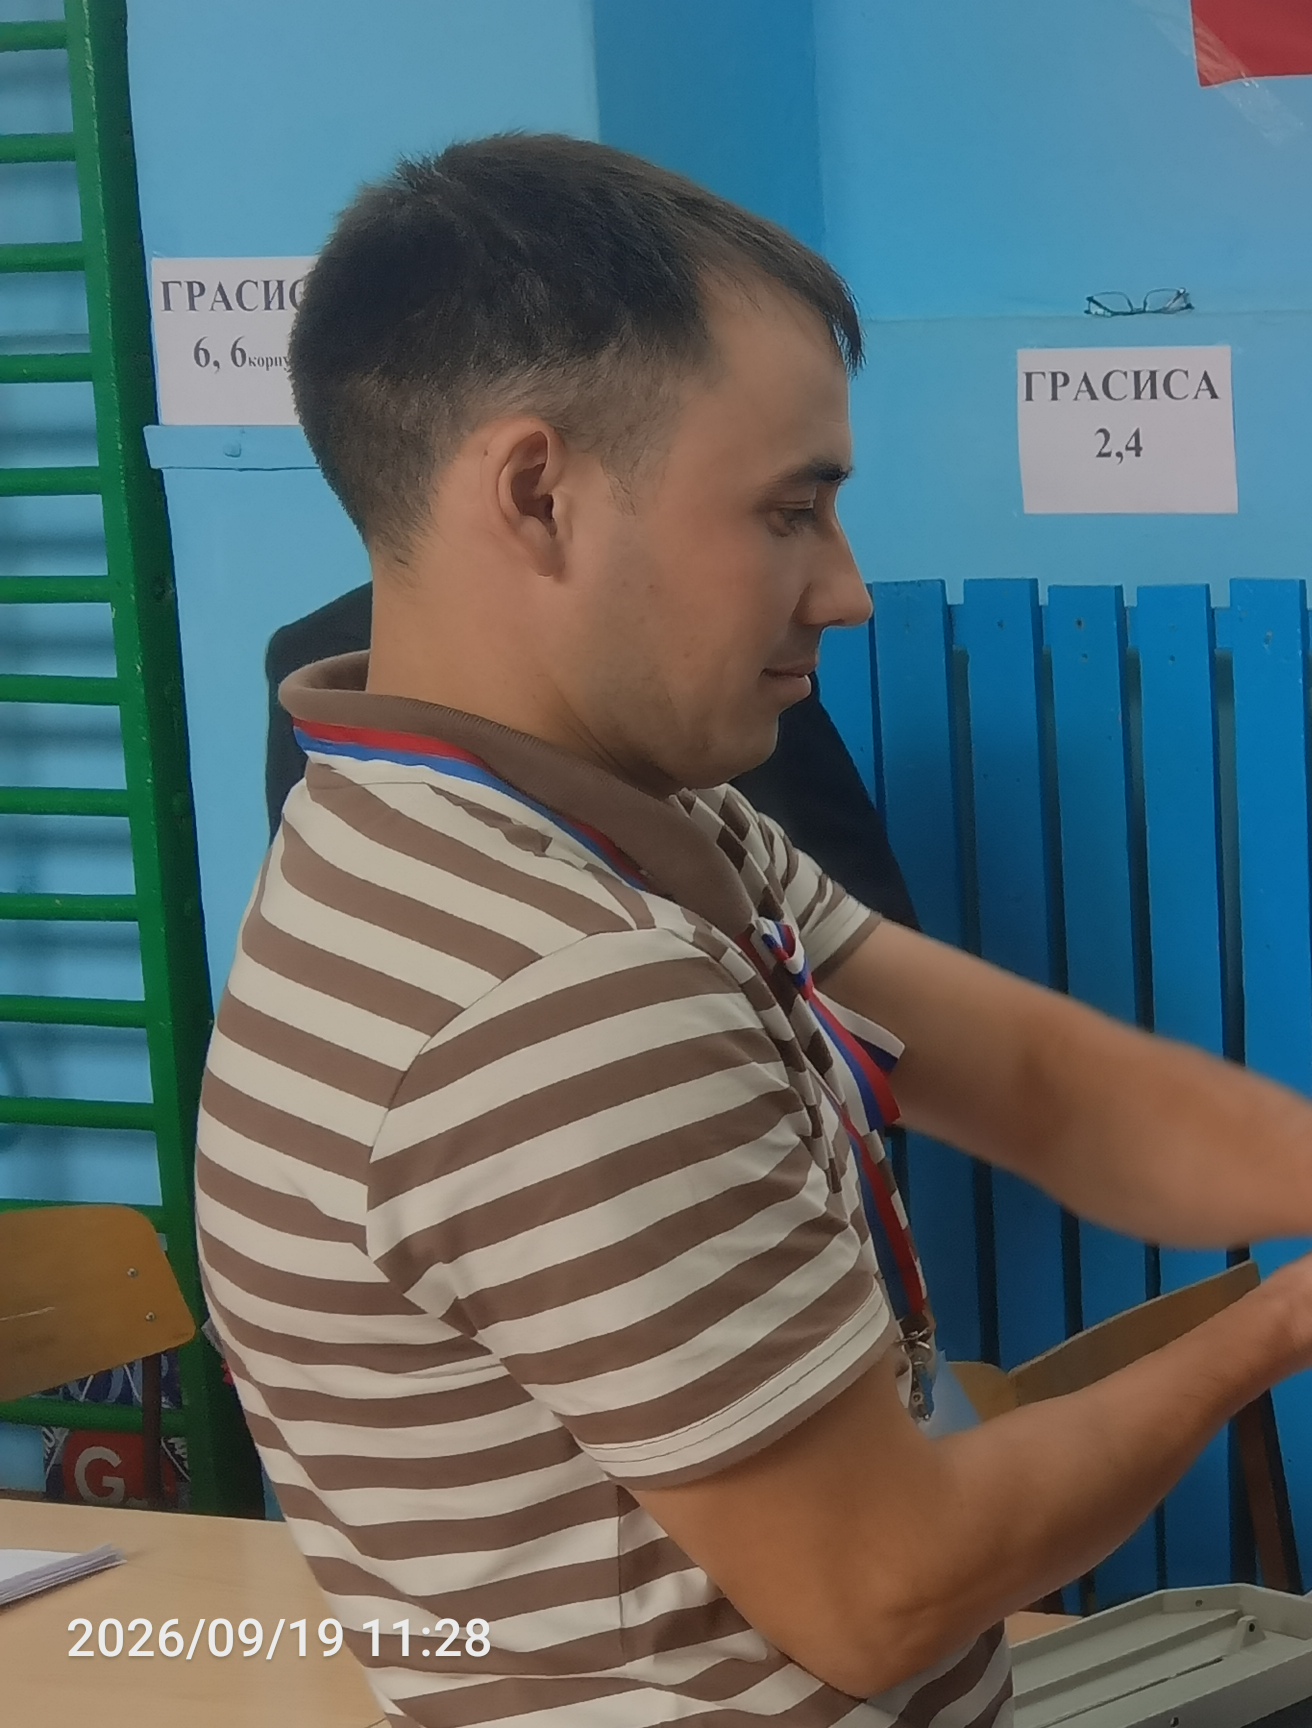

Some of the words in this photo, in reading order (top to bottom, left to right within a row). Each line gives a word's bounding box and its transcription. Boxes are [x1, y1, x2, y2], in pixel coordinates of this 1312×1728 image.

[160, 279, 303, 312] ГРАСИС
[1023, 369, 1219, 401] ГРАСИСА
[1094, 427, 1143, 465] 2,4
